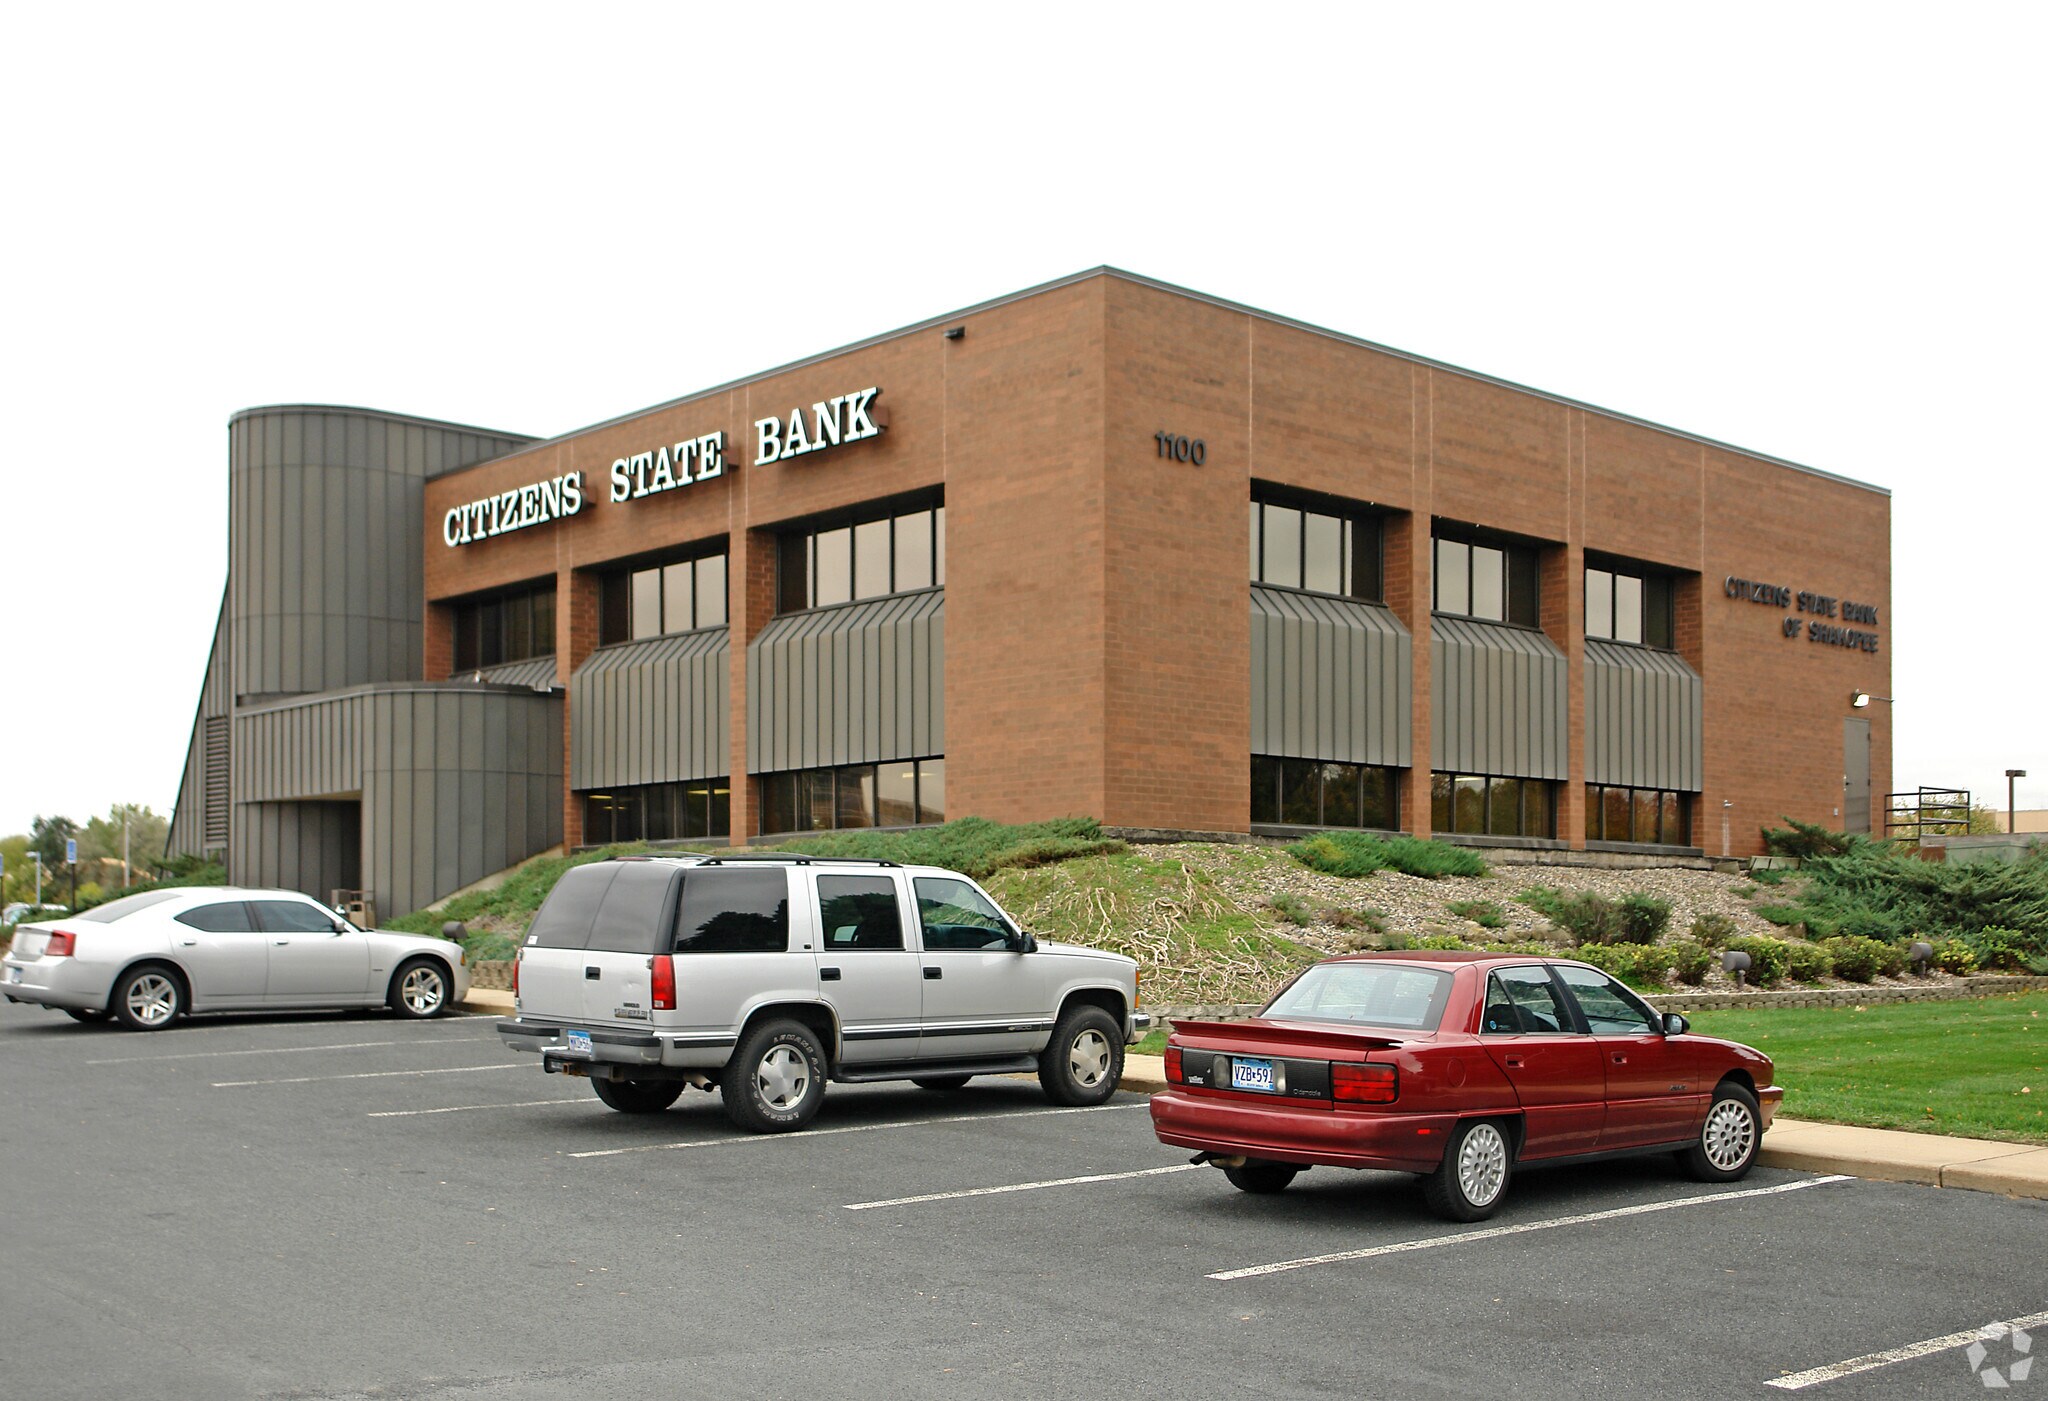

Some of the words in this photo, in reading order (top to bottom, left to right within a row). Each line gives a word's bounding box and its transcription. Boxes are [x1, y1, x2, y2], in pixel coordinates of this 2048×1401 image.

[443, 470, 582, 548] CITIZENS
[610, 431, 723, 503] STATE
[754, 387, 879, 466] BANK
[1155, 430, 1207, 466] 1100
[1725, 575, 1791, 608] CITIZENS
[1797, 590, 1838, 618] STATE
[1842, 601, 1878, 625] BANK
[1783, 616, 1802, 638] OF
[1809, 620, 1878, 653] SHAKOPEE
